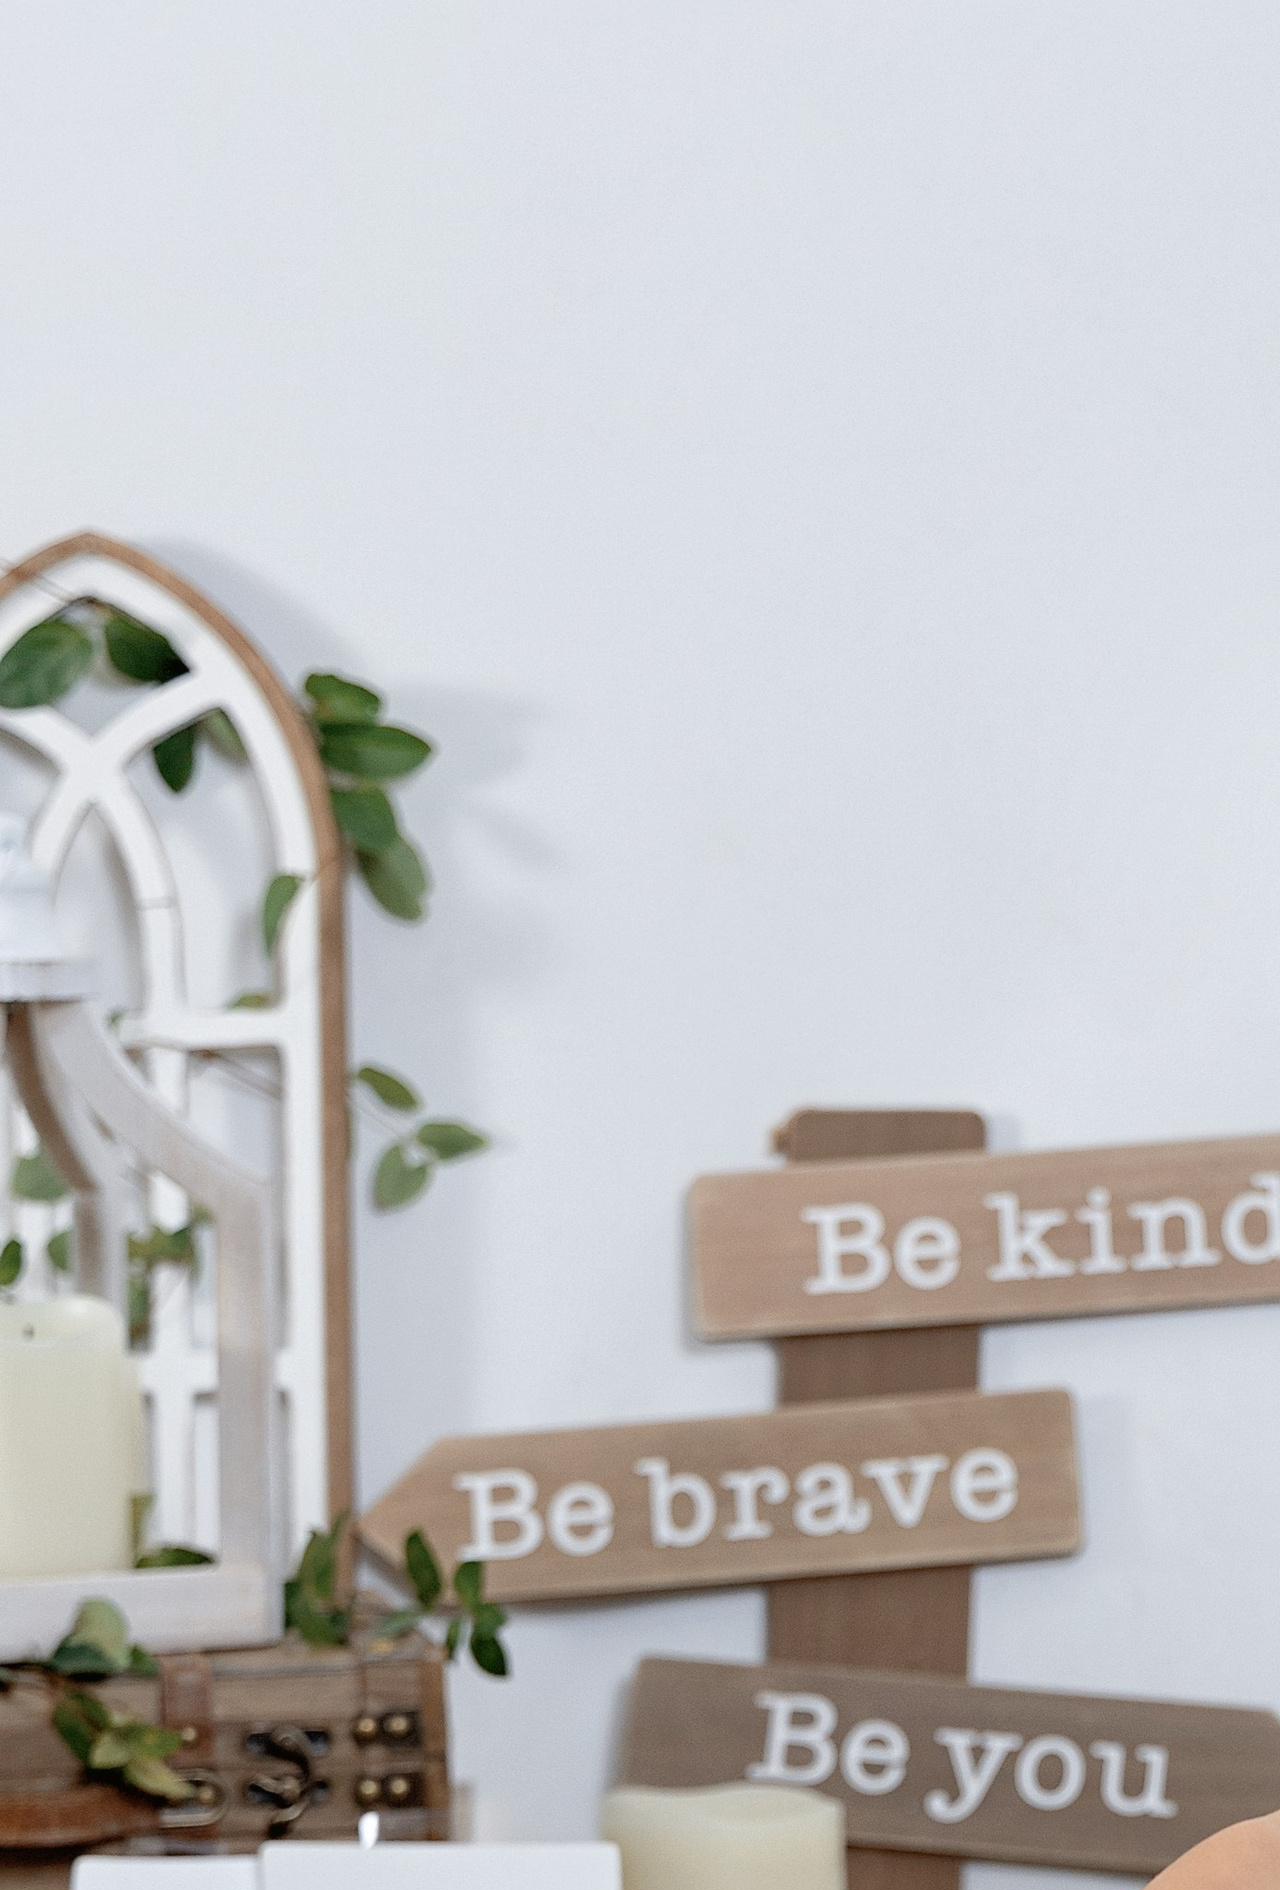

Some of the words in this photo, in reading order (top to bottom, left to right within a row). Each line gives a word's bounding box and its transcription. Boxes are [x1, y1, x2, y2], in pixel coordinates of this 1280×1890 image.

[803, 1203, 960, 1294] Be
[456, 1468, 614, 1561] Be
[635, 1447, 1018, 1548] brave
[746, 1691, 908, 1791] Be
[925, 1727, 1178, 1822] you
